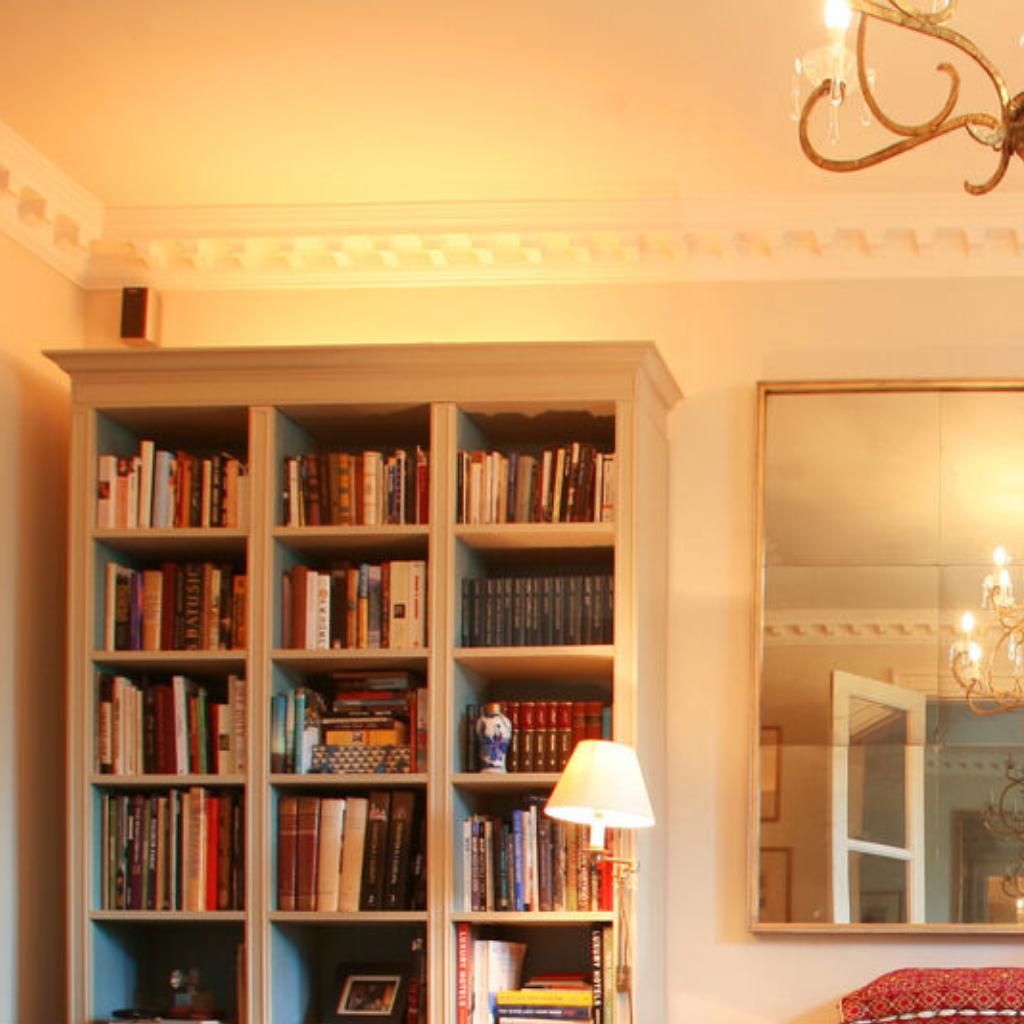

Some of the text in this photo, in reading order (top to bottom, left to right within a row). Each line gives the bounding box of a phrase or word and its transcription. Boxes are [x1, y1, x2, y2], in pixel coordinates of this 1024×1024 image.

[592, 930, 601, 967] LUXURY
[459, 931, 467, 1006] LUXURY HOTELS
[592, 970, 601, 1006] HOTELS
